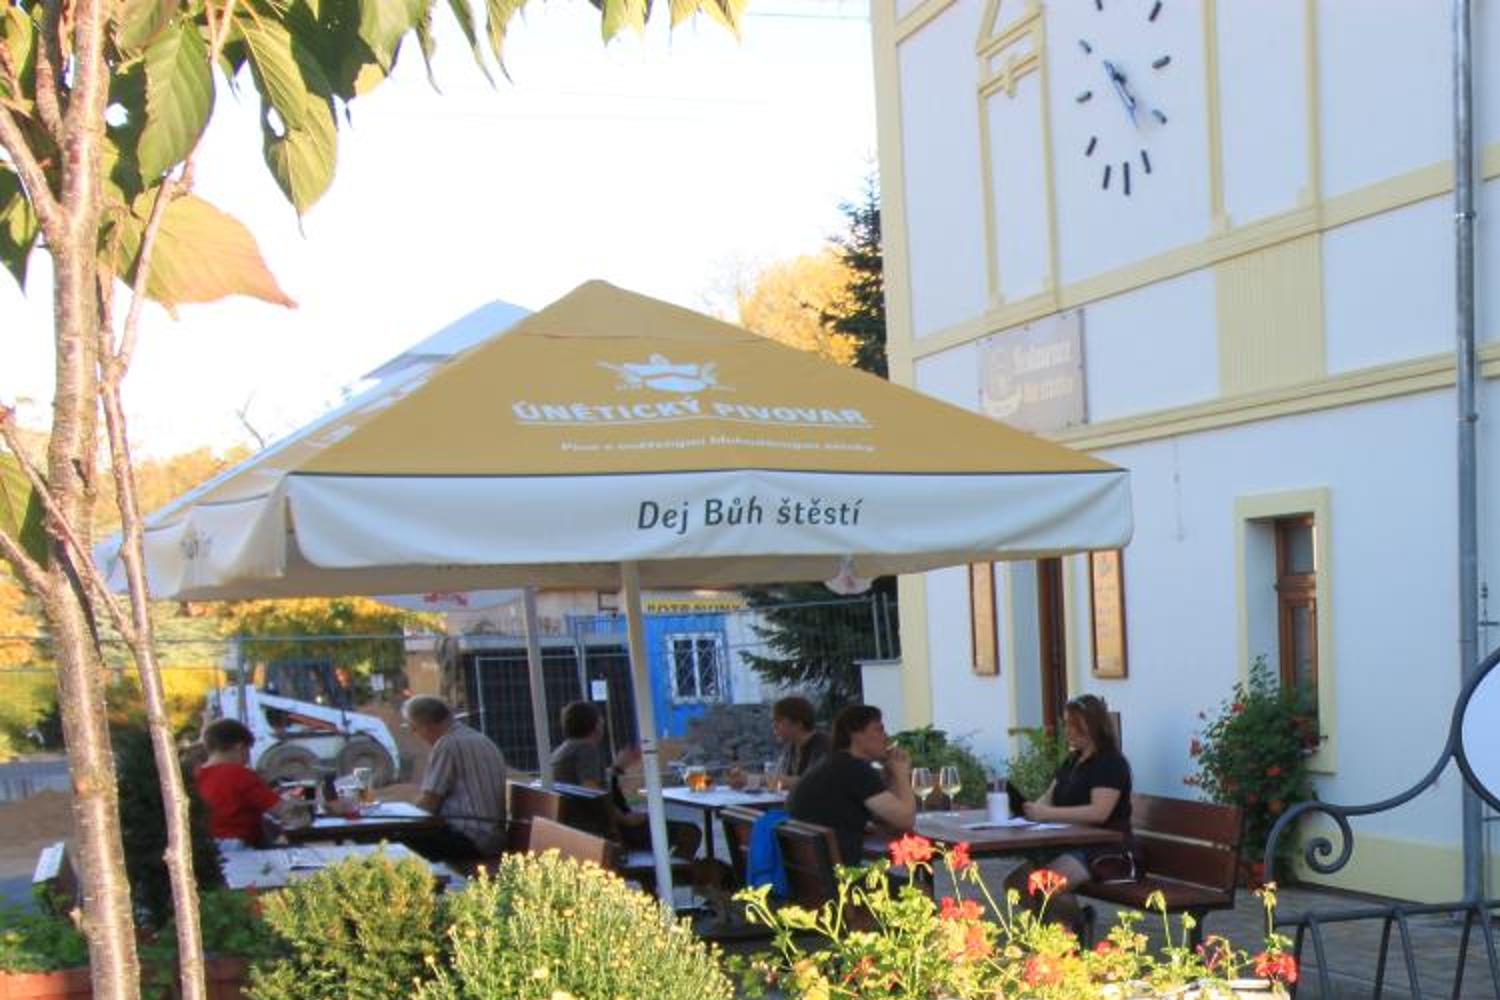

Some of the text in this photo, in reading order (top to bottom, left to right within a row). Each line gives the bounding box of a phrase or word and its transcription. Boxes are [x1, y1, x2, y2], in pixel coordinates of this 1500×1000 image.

[713, 403, 867, 424] PIVOVAR
[638, 496, 863, 535] Dej Bůh štěstí
